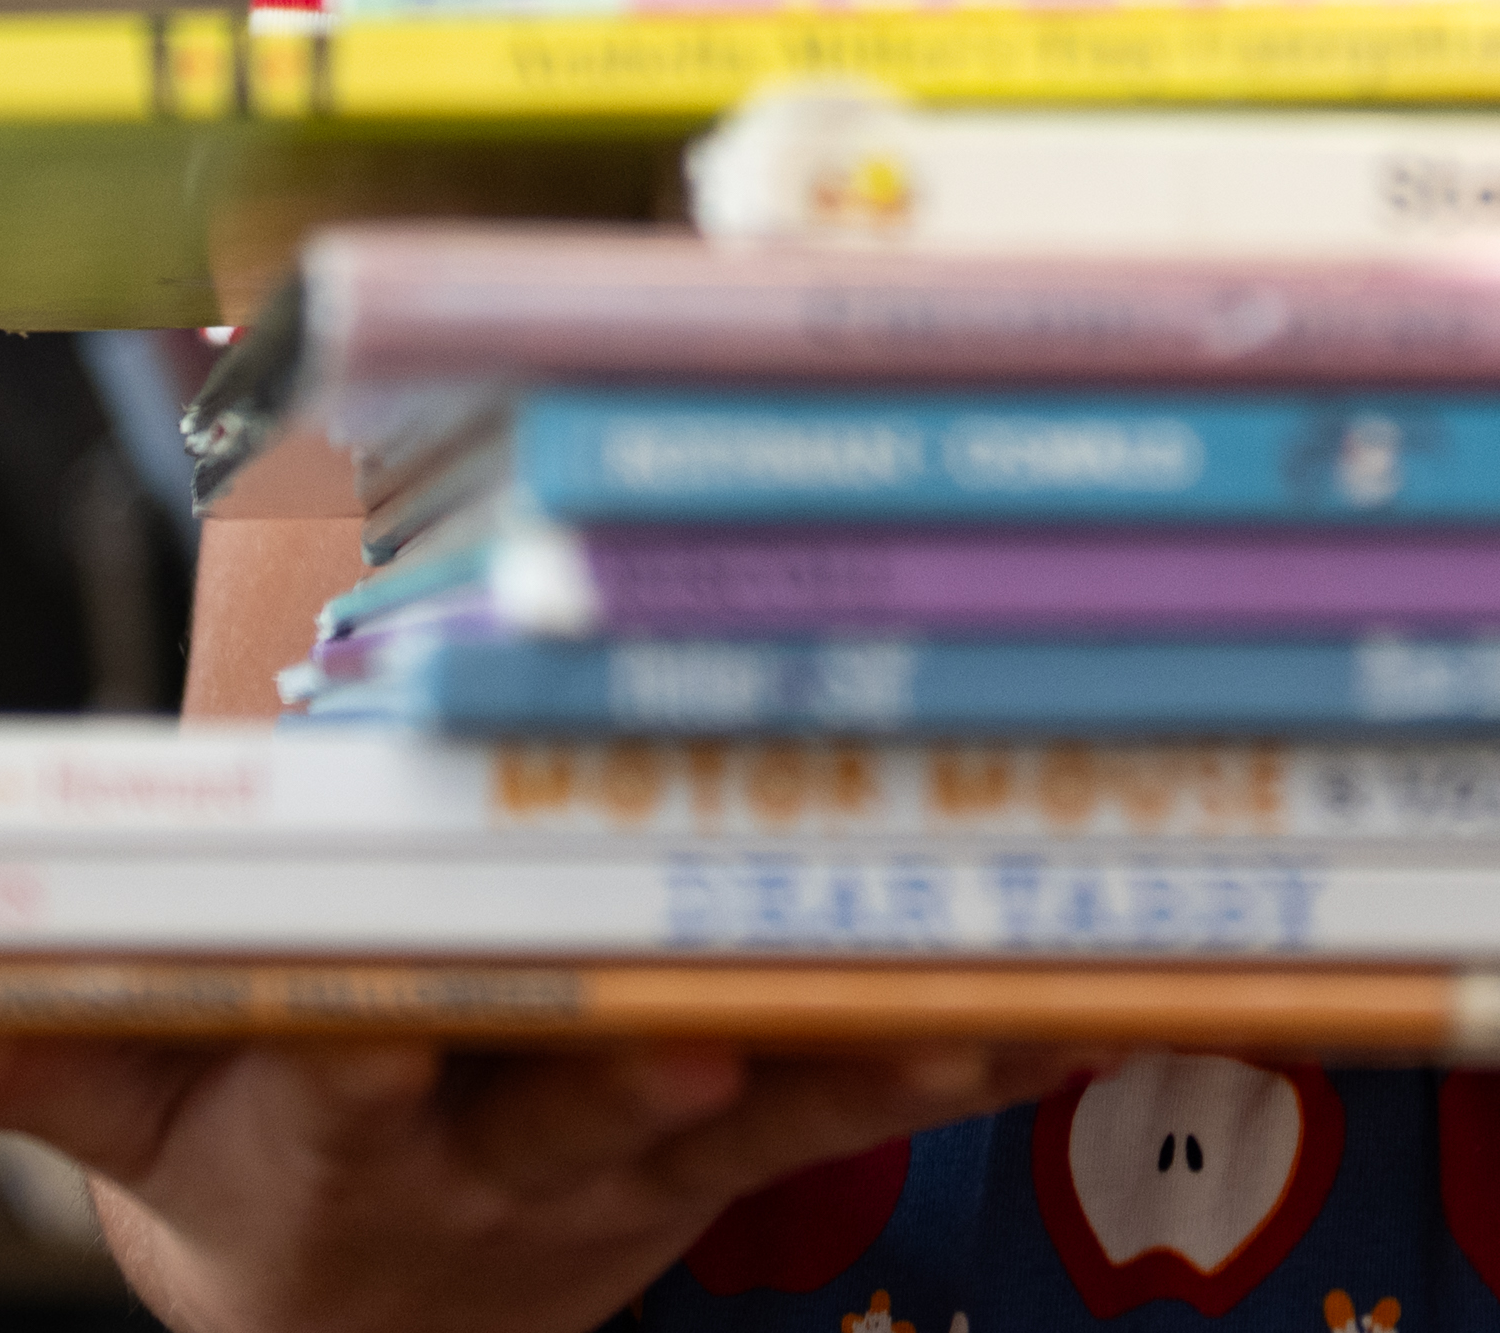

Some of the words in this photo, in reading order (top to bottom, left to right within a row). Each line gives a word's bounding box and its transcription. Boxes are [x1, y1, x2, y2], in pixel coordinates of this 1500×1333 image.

[45, 759, 264, 815] Howard
[489, 735, 880, 823] MOTOR
[926, 735, 1291, 821] MOUSE
[660, 855, 955, 945] DEAR
[987, 855, 1326, 945] TABBY
